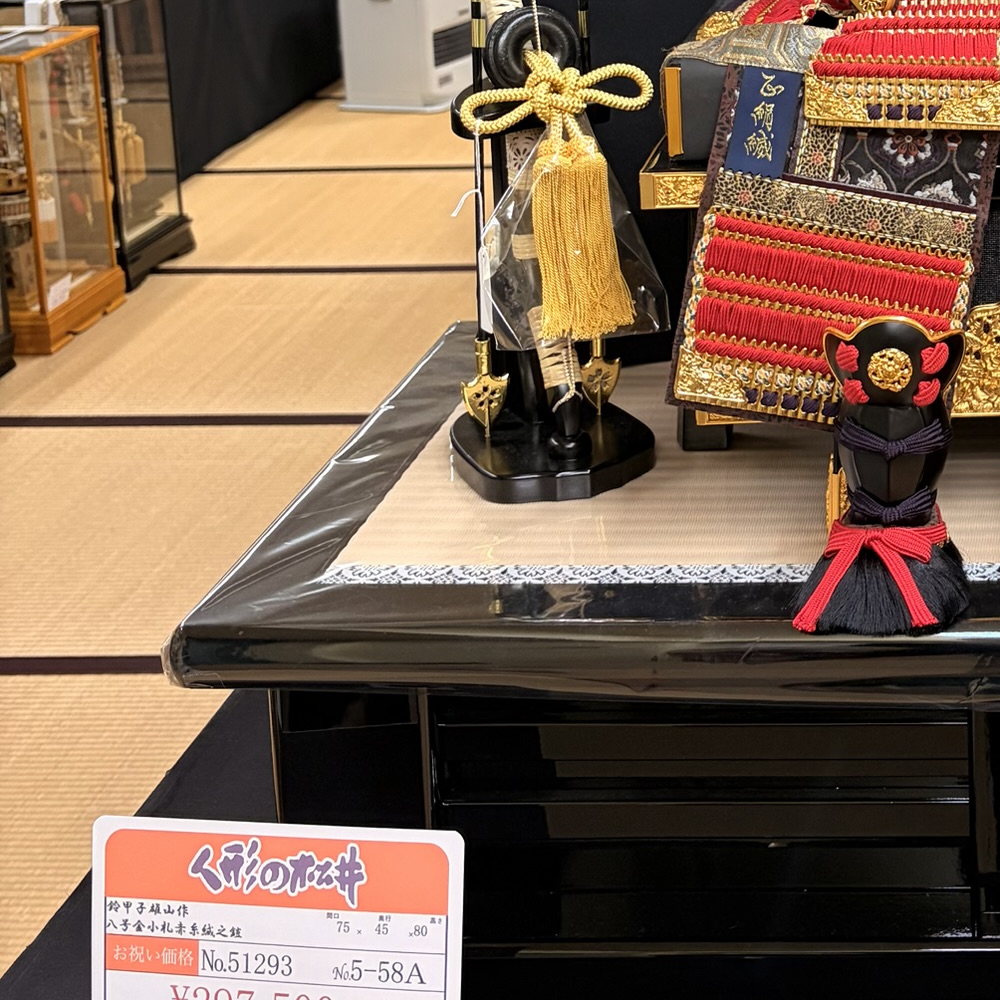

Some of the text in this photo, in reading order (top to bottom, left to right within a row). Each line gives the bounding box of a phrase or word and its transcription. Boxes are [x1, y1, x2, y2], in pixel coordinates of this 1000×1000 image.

[188, 837, 367, 909] 人形の松井
[106, 900, 190, 918] 鈴甲子雄山作
[336, 921, 351, 934] 75
[374, 923, 390, 936] 45
[113, 944, 194, 967] お祝い価格
[201, 948, 293, 977] No.51293
